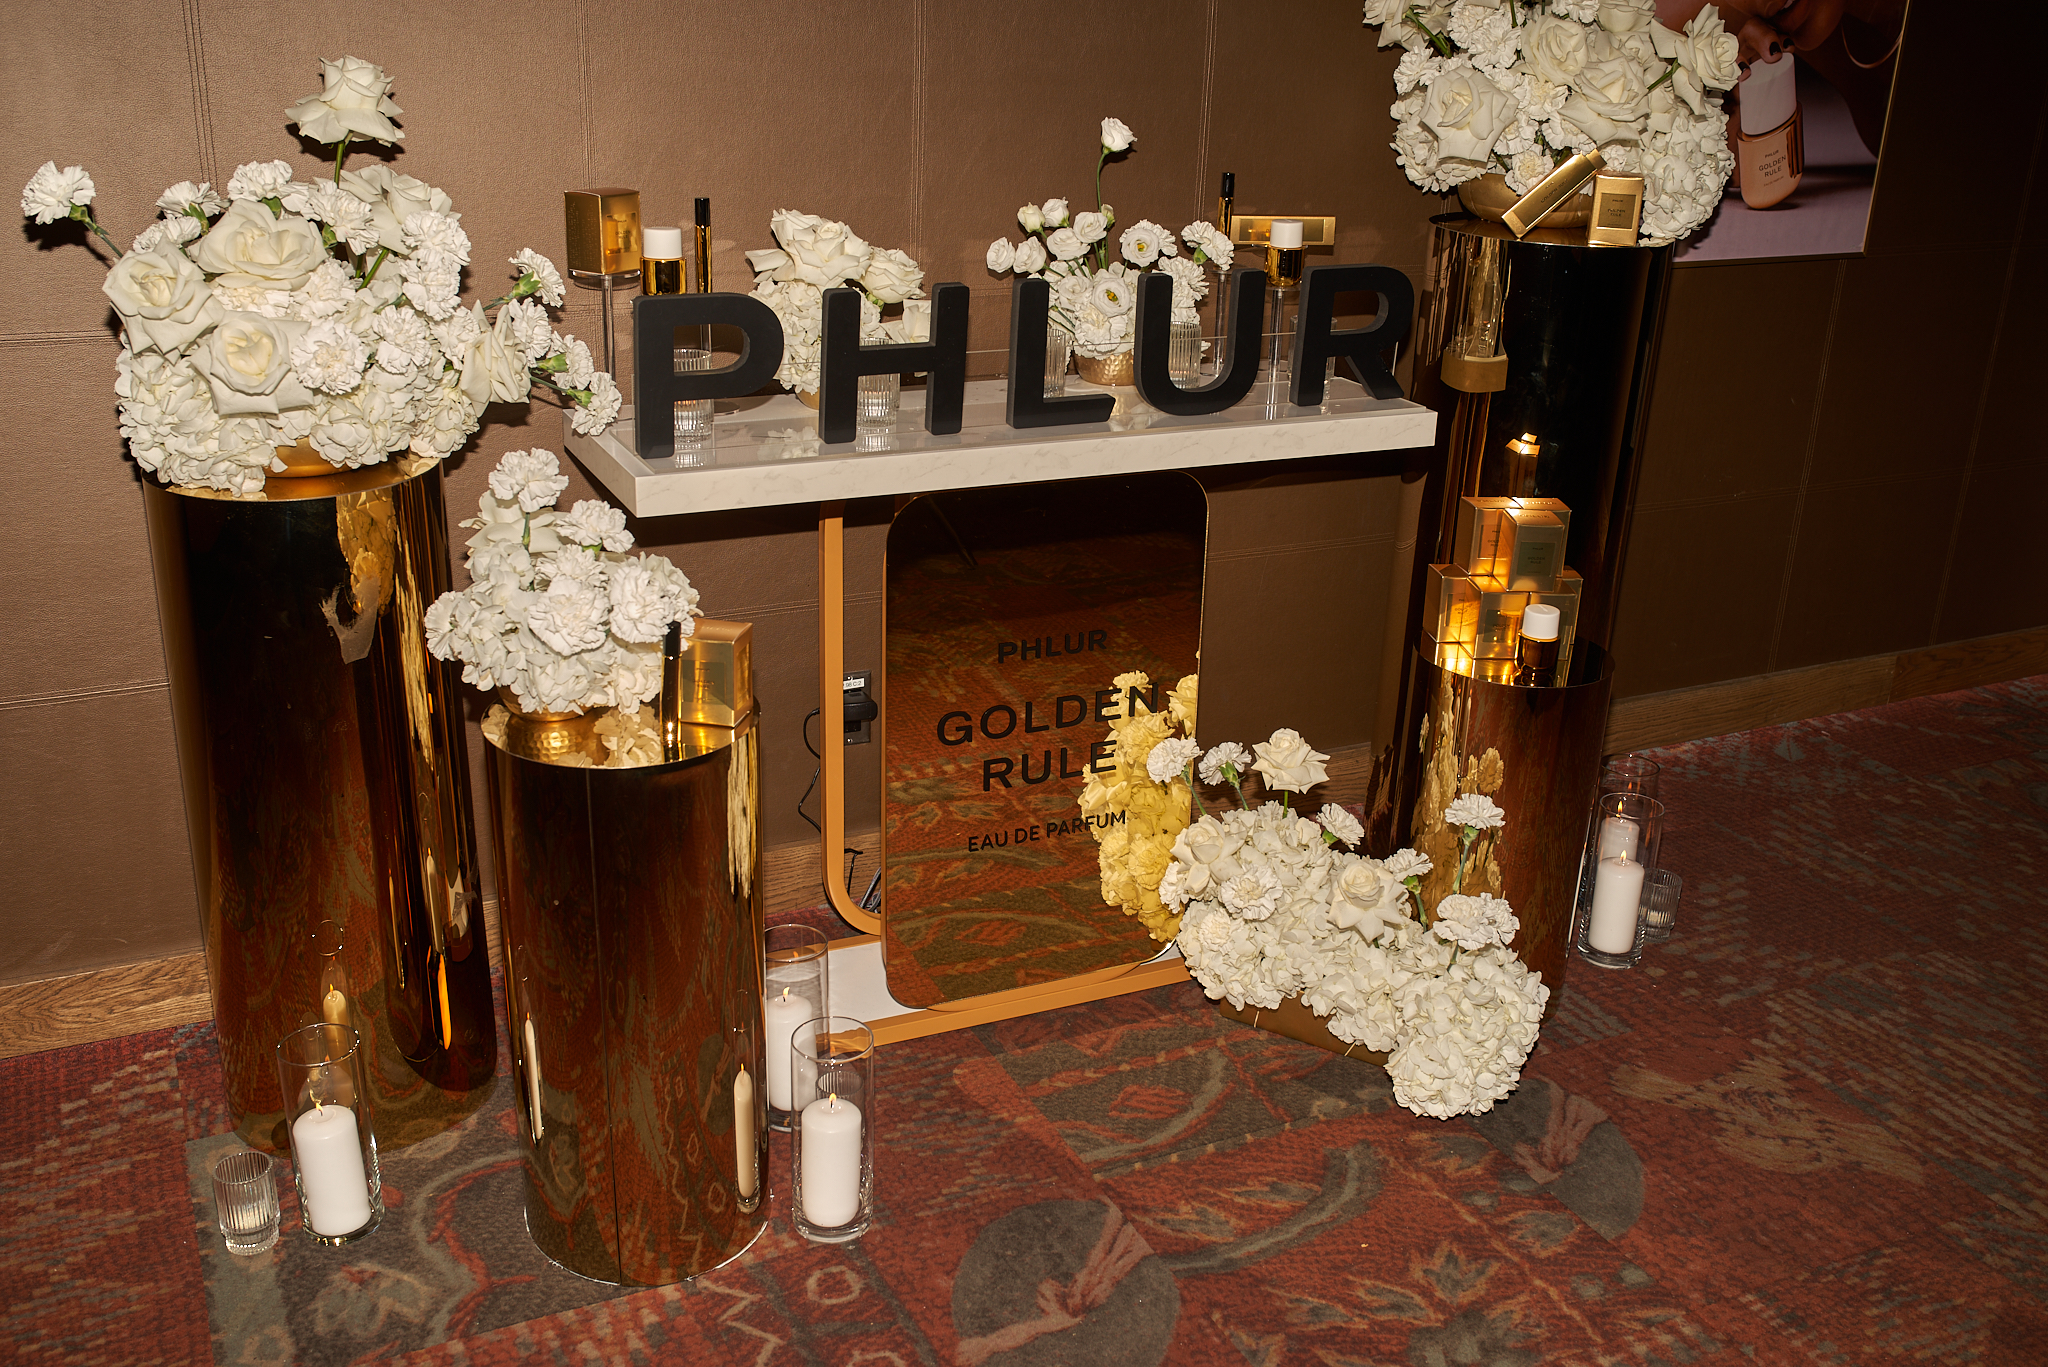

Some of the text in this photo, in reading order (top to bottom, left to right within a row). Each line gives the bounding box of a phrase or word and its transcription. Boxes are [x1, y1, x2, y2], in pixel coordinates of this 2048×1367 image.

[1758, 154, 1787, 172] GOLDEN
[1764, 165, 1782, 178] RULE
[633, 265, 1415, 459] PHLUR
[998, 629, 1108, 664] PHLUR
[936, 682, 1159, 746] GOLDEN
[982, 739, 1118, 792] RULE
[968, 809, 1126, 852] EAU DE PARFUM
